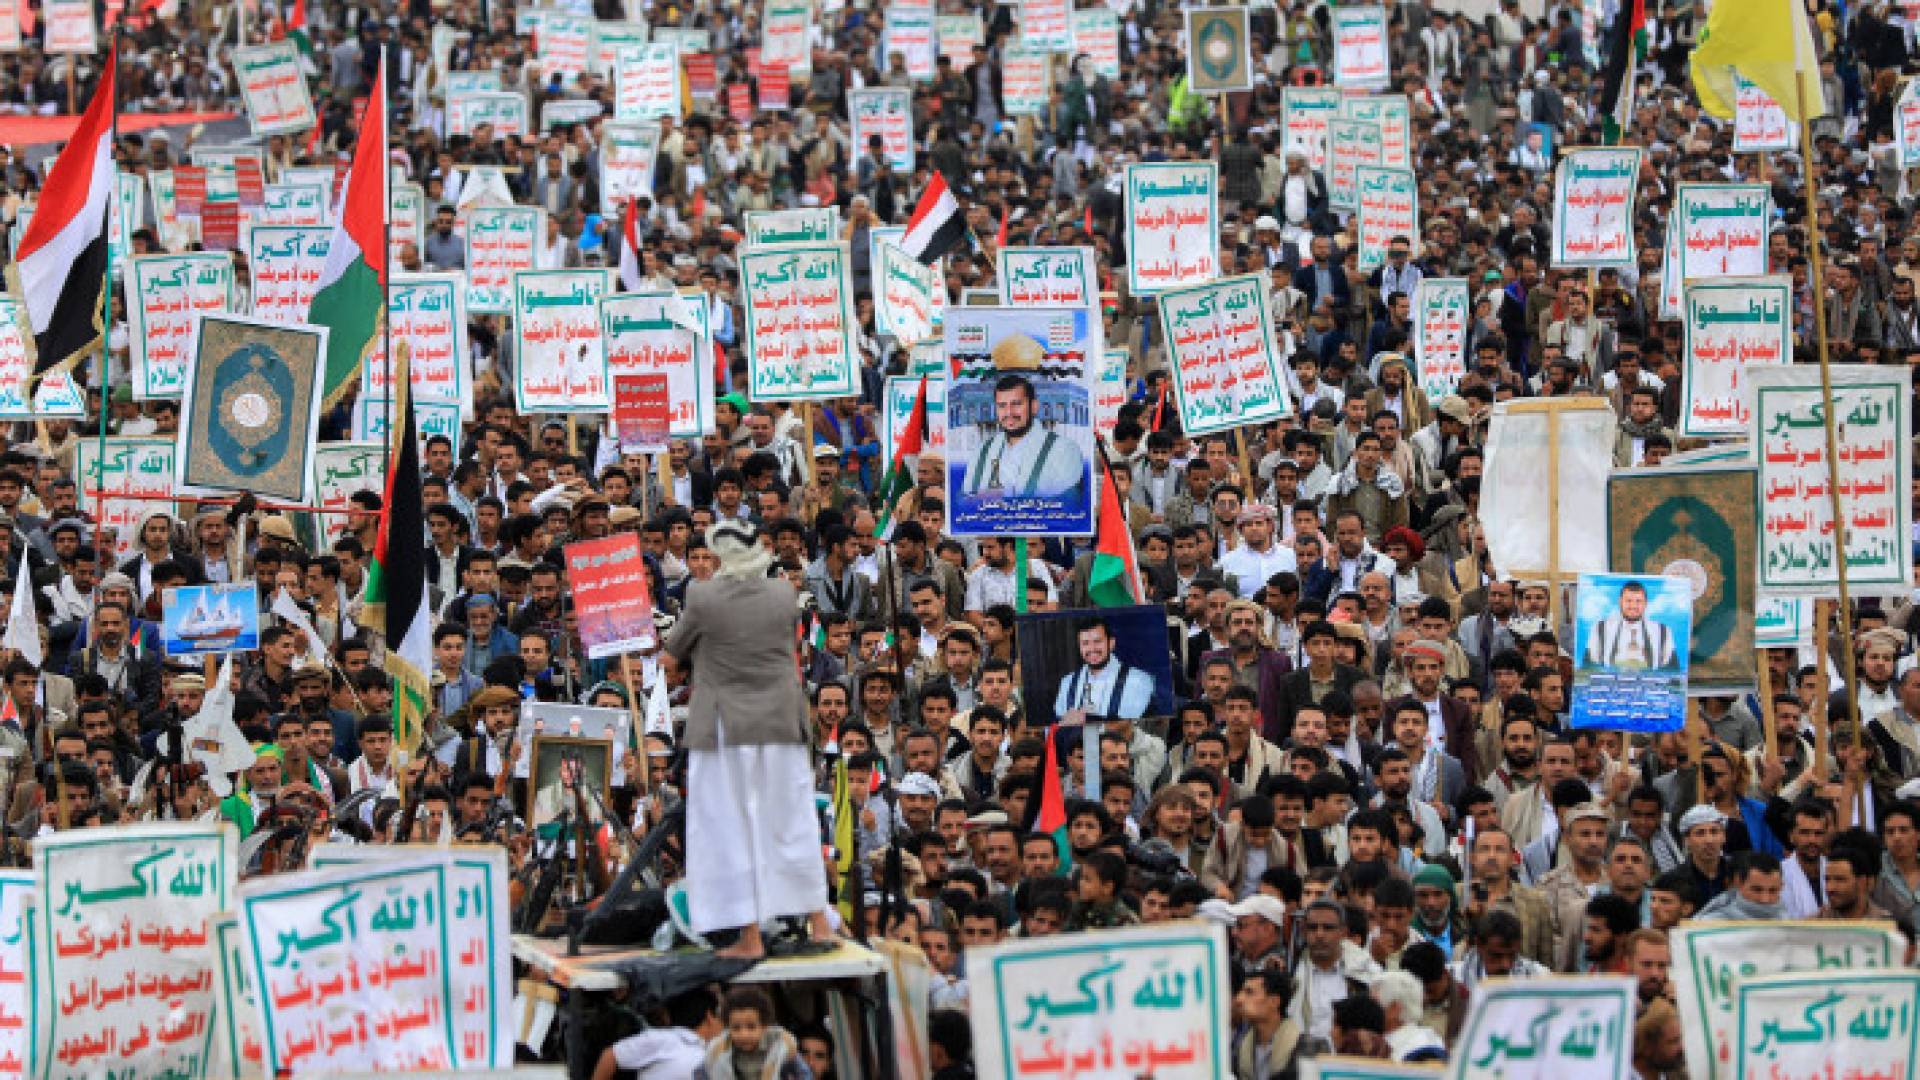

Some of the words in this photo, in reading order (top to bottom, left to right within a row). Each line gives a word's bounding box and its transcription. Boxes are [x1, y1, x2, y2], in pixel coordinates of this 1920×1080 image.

[1134, 172, 1210, 203] قاطعوا
[1684, 195, 1763, 225] قاطعوا
[144, 262, 193, 296] أكبر
[752, 255, 801, 291] أكبر
[804, 256, 836, 279] الله
[1012, 255, 1051, 286] أكبر
[1172, 290, 1220, 329] أكبر
[1223, 286, 1257, 312] الله
[1692, 296, 1781, 331] قاطعوا
[1846, 396, 1895, 427] الله
[139, 450, 172, 475] الله
[1767, 541, 1833, 580] للإسلام
[55, 842, 176, 922] أكبر
[168, 848, 218, 897] الله
[369, 884, 435, 932] الله
[56, 912, 132, 960] لأمريكا
[137, 918, 209, 954] لموت
[267, 888, 363, 971] أكبر
[139, 967, 214, 1001] الموت
[270, 953, 361, 1012] لأمريكا
[366, 947, 437, 992] الموت
[1132, 958, 1204, 1010] الله
[1015, 950, 1127, 1036] أكبر
[1558, 1010, 1616, 1059] الله
[1749, 989, 1848, 1060] أكبر
[1847, 995, 1909, 1040] الله
[1121, 1028, 1208, 1077] الموت
[1472, 1003, 1562, 1076] أكبر
